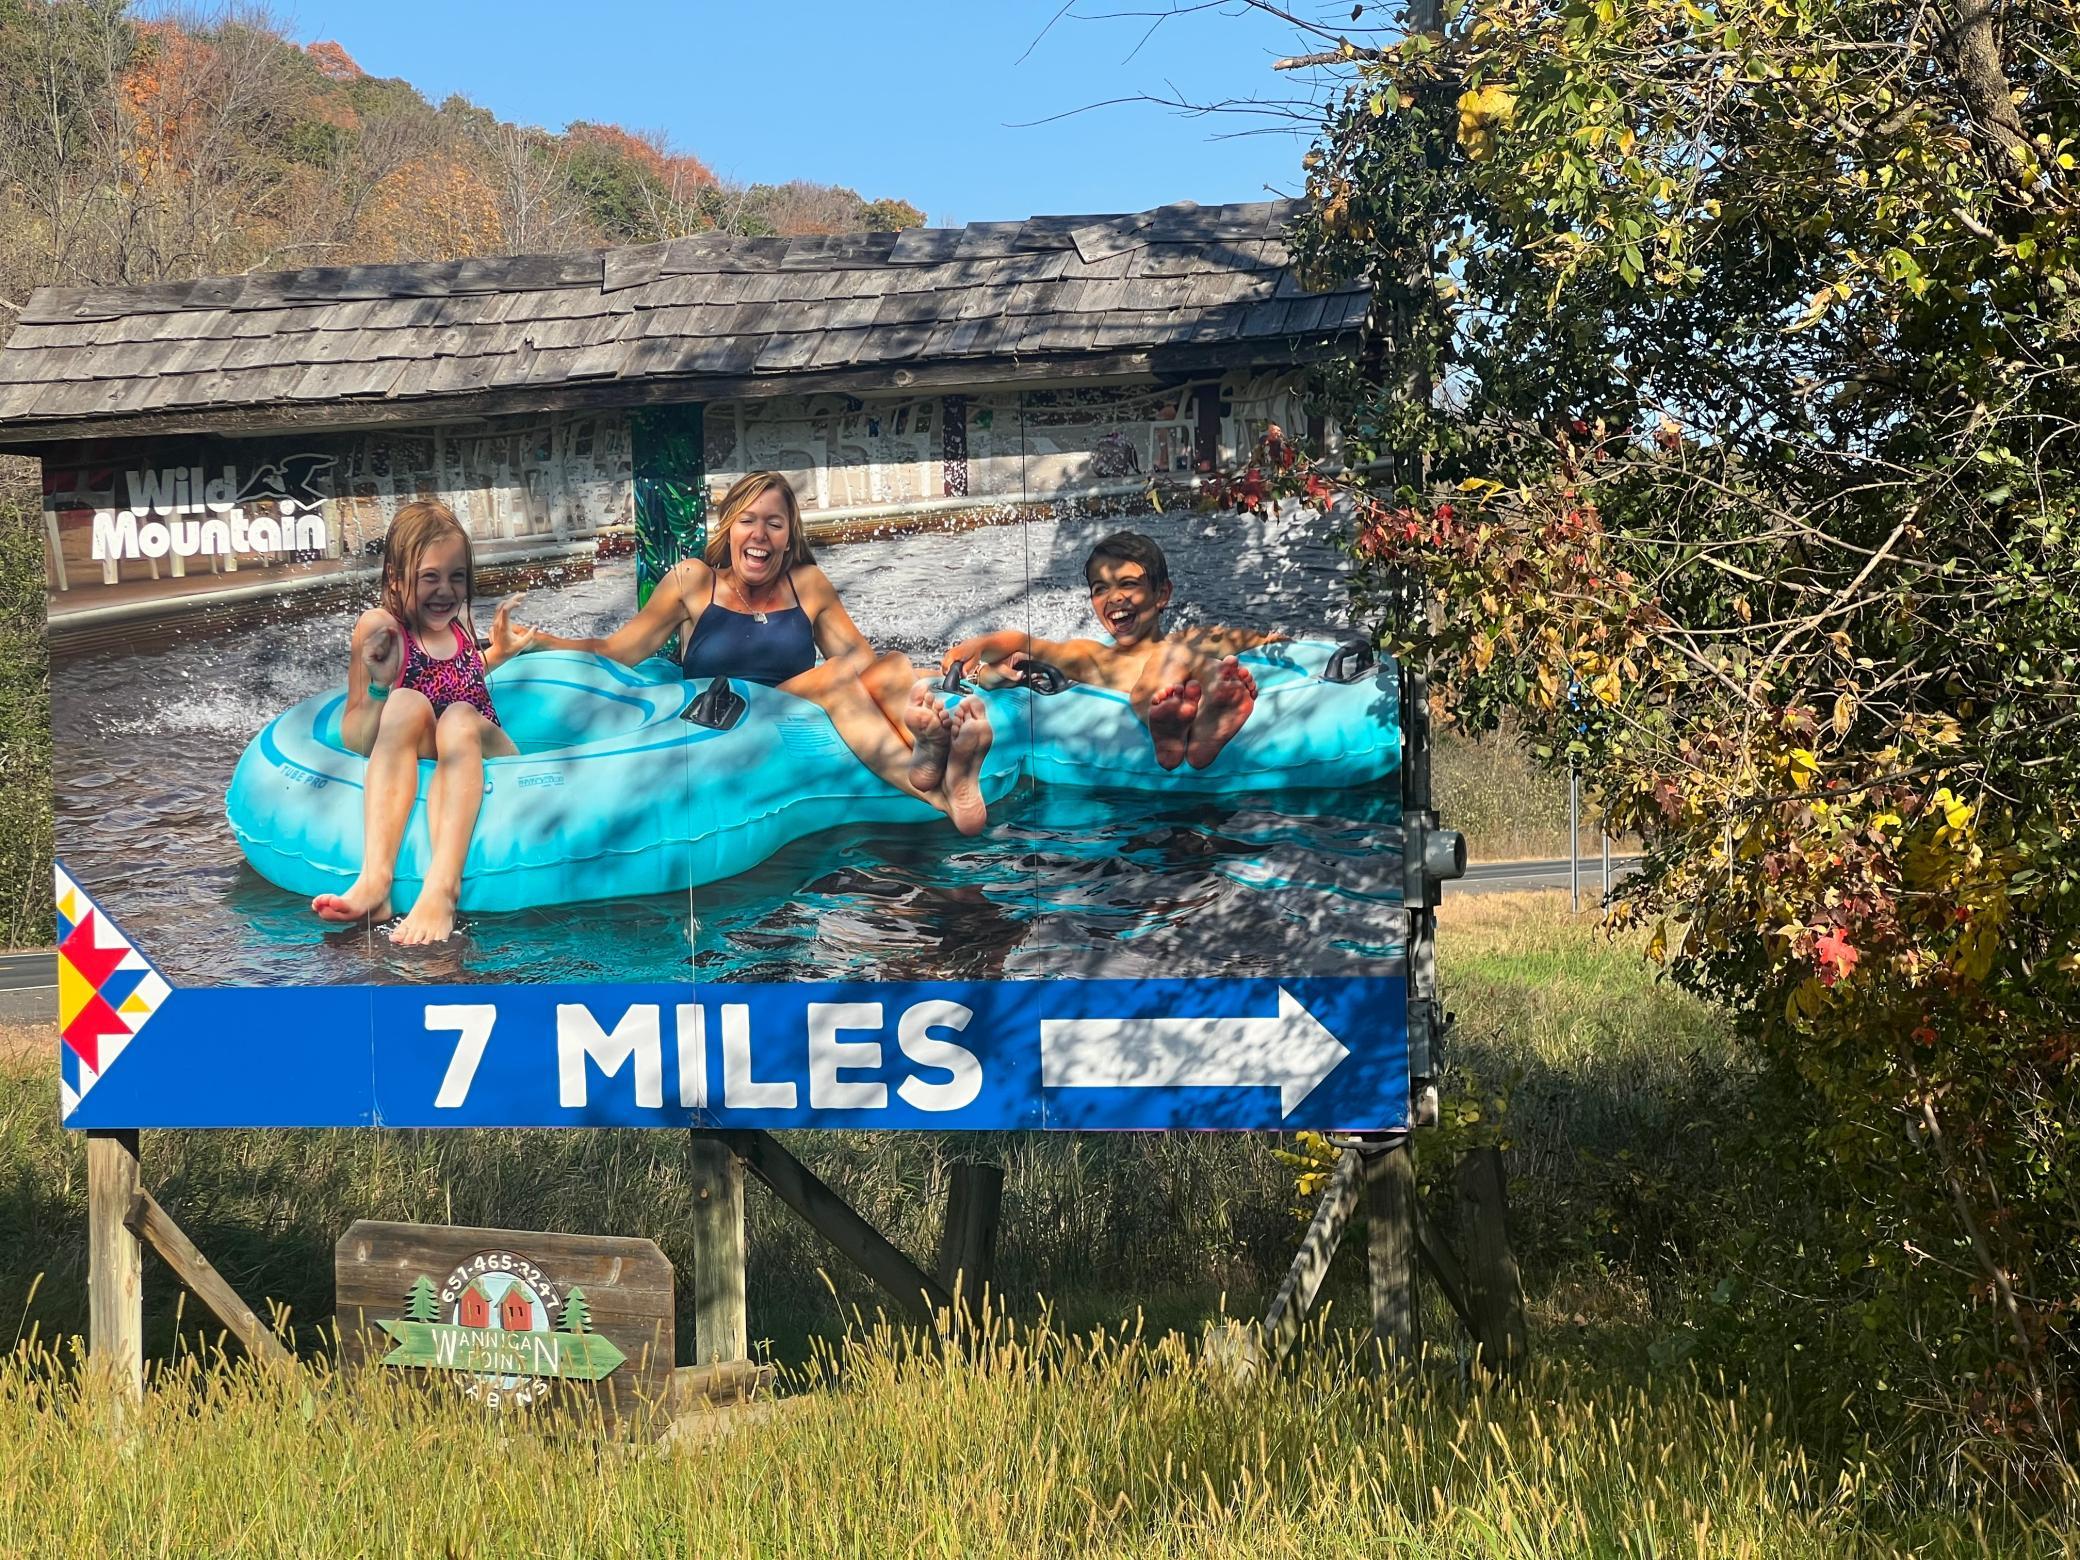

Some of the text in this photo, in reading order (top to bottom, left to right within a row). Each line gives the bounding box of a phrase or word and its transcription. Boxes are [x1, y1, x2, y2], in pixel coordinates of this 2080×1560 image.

[125, 465, 237, 517] Wild
[92, 499, 326, 560] Mountain
[280, 765, 329, 789] TUBE PRO
[424, 1000, 983, 1112] 7 MILES
[441, 1254, 560, 1309] 651-465-3247
[431, 1328, 559, 1374] WANNIGAN
[455, 1372, 548, 1408] ABNS
